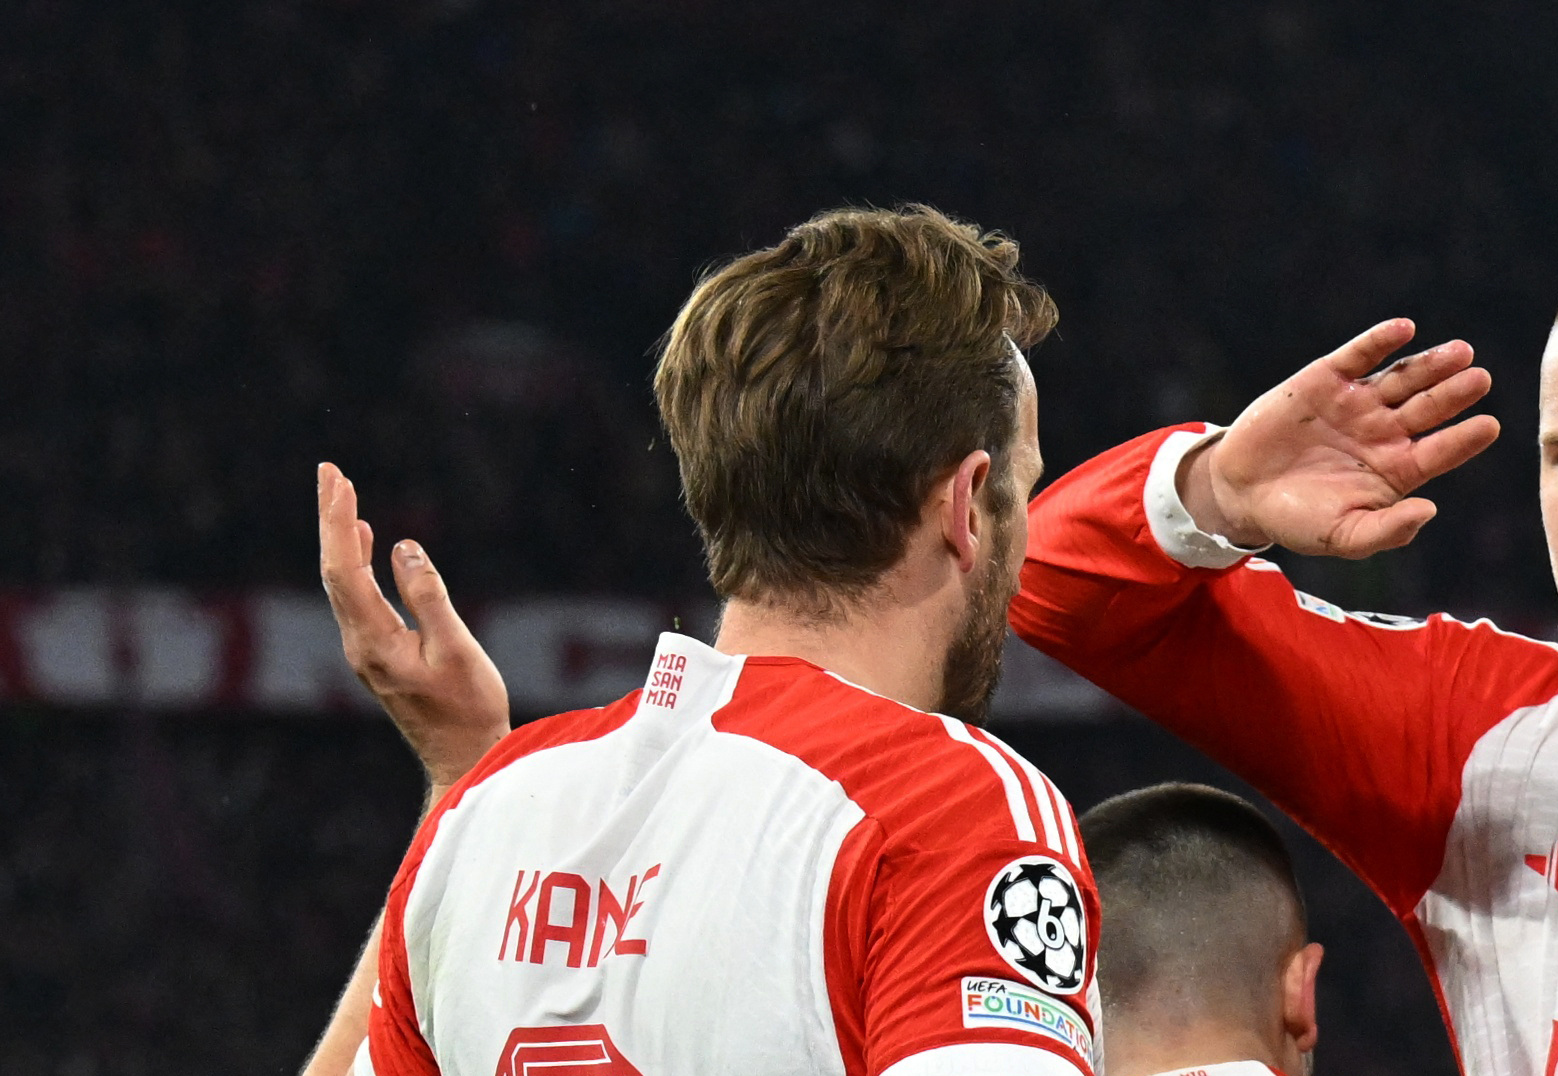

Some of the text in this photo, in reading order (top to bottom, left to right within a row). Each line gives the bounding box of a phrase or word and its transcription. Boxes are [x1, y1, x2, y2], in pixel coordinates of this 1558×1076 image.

[657, 653, 687, 672] MIA
[651, 671, 683, 691] SAN
[646, 689, 677, 709] MIA
[498, 863, 661, 968] KANE
[966, 980, 1007, 994] UEFA
